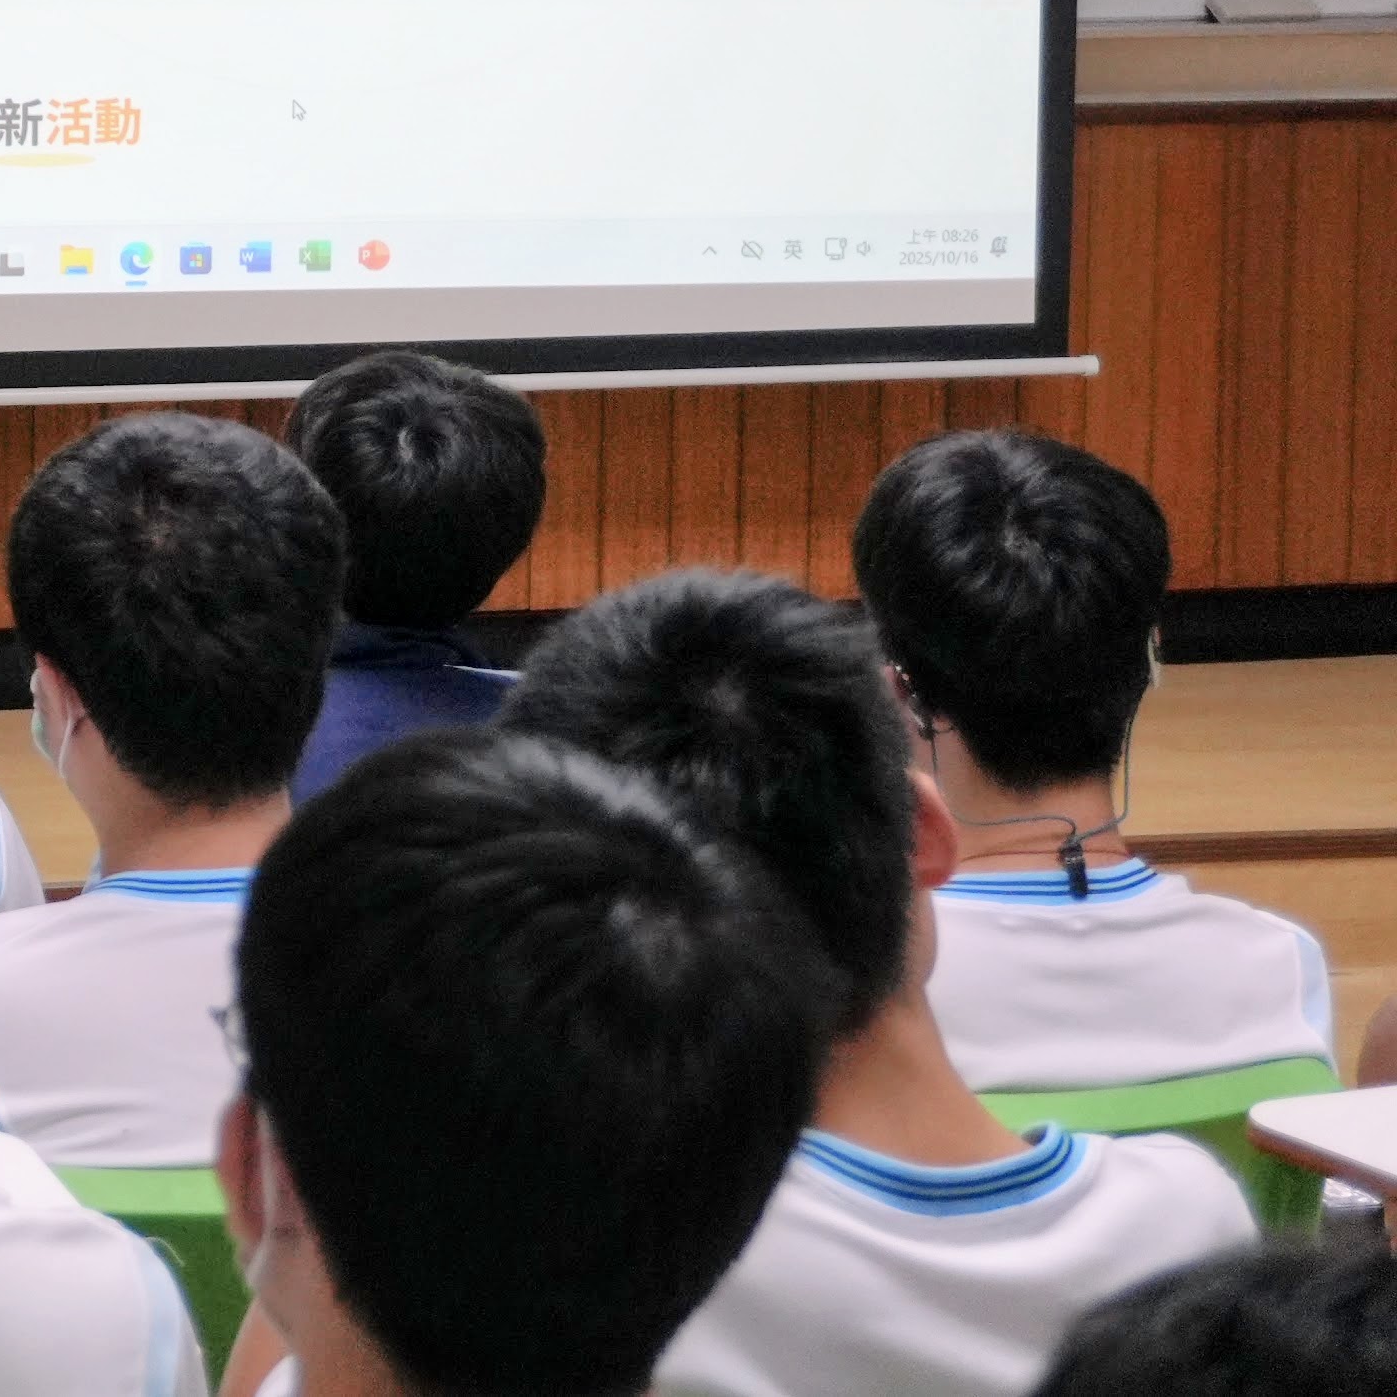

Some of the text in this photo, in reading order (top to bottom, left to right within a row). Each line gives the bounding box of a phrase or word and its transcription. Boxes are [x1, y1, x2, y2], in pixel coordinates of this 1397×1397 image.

[907, 228, 979, 245] 上午 08:26
[784, 240, 802, 260] 英
[899, 251, 979, 266] 2025/10/16
